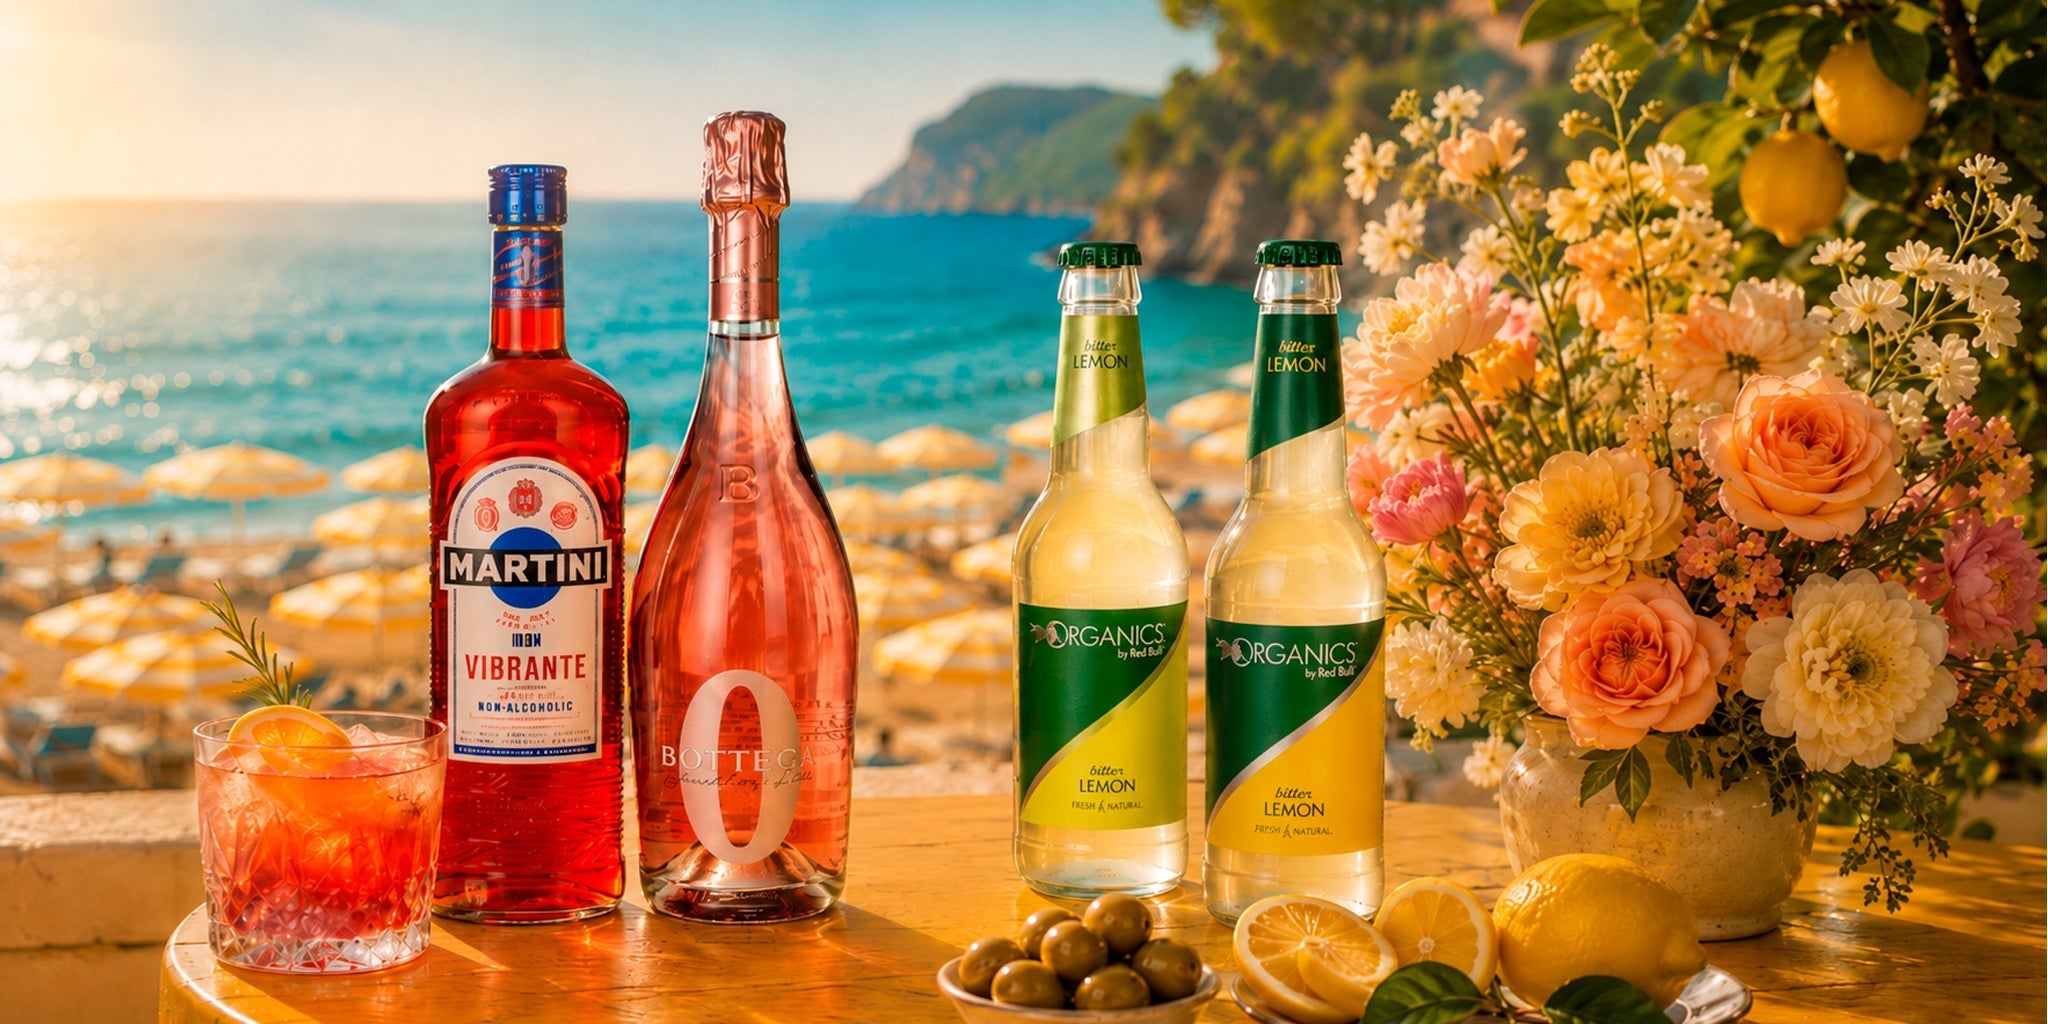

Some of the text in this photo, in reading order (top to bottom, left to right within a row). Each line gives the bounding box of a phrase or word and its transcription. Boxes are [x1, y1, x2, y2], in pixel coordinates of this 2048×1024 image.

[1083, 339, 1116, 352] bitter
[1278, 339, 1315, 353] bitter
[1073, 354, 1128, 369] LEMON
[1267, 356, 1326, 373] LEMON
[719, 464, 761, 504] B
[449, 552, 602, 583] MARTINI
[1046, 620, 1164, 649] ORGANICS
[1117, 648, 1129, 659] by
[1130, 648, 1146, 658] Red
[1232, 637, 1356, 667] ORGANICS
[465, 653, 586, 681] VIBRANTE
[1305, 670, 1316, 680] by
[1318, 668, 1336, 678] Red
[478, 701, 573, 713] NON-ALCOHOLIC
[660, 745, 816, 772] BOTTEGA
[1089, 765, 1124, 776] bitter
[1079, 779, 1136, 793] LEMON
[1274, 787, 1312, 799] bitter
[1071, 802, 1096, 810] FRESH
[1264, 802, 1325, 817] LEMON
[1254, 825, 1280, 834] FRESH
